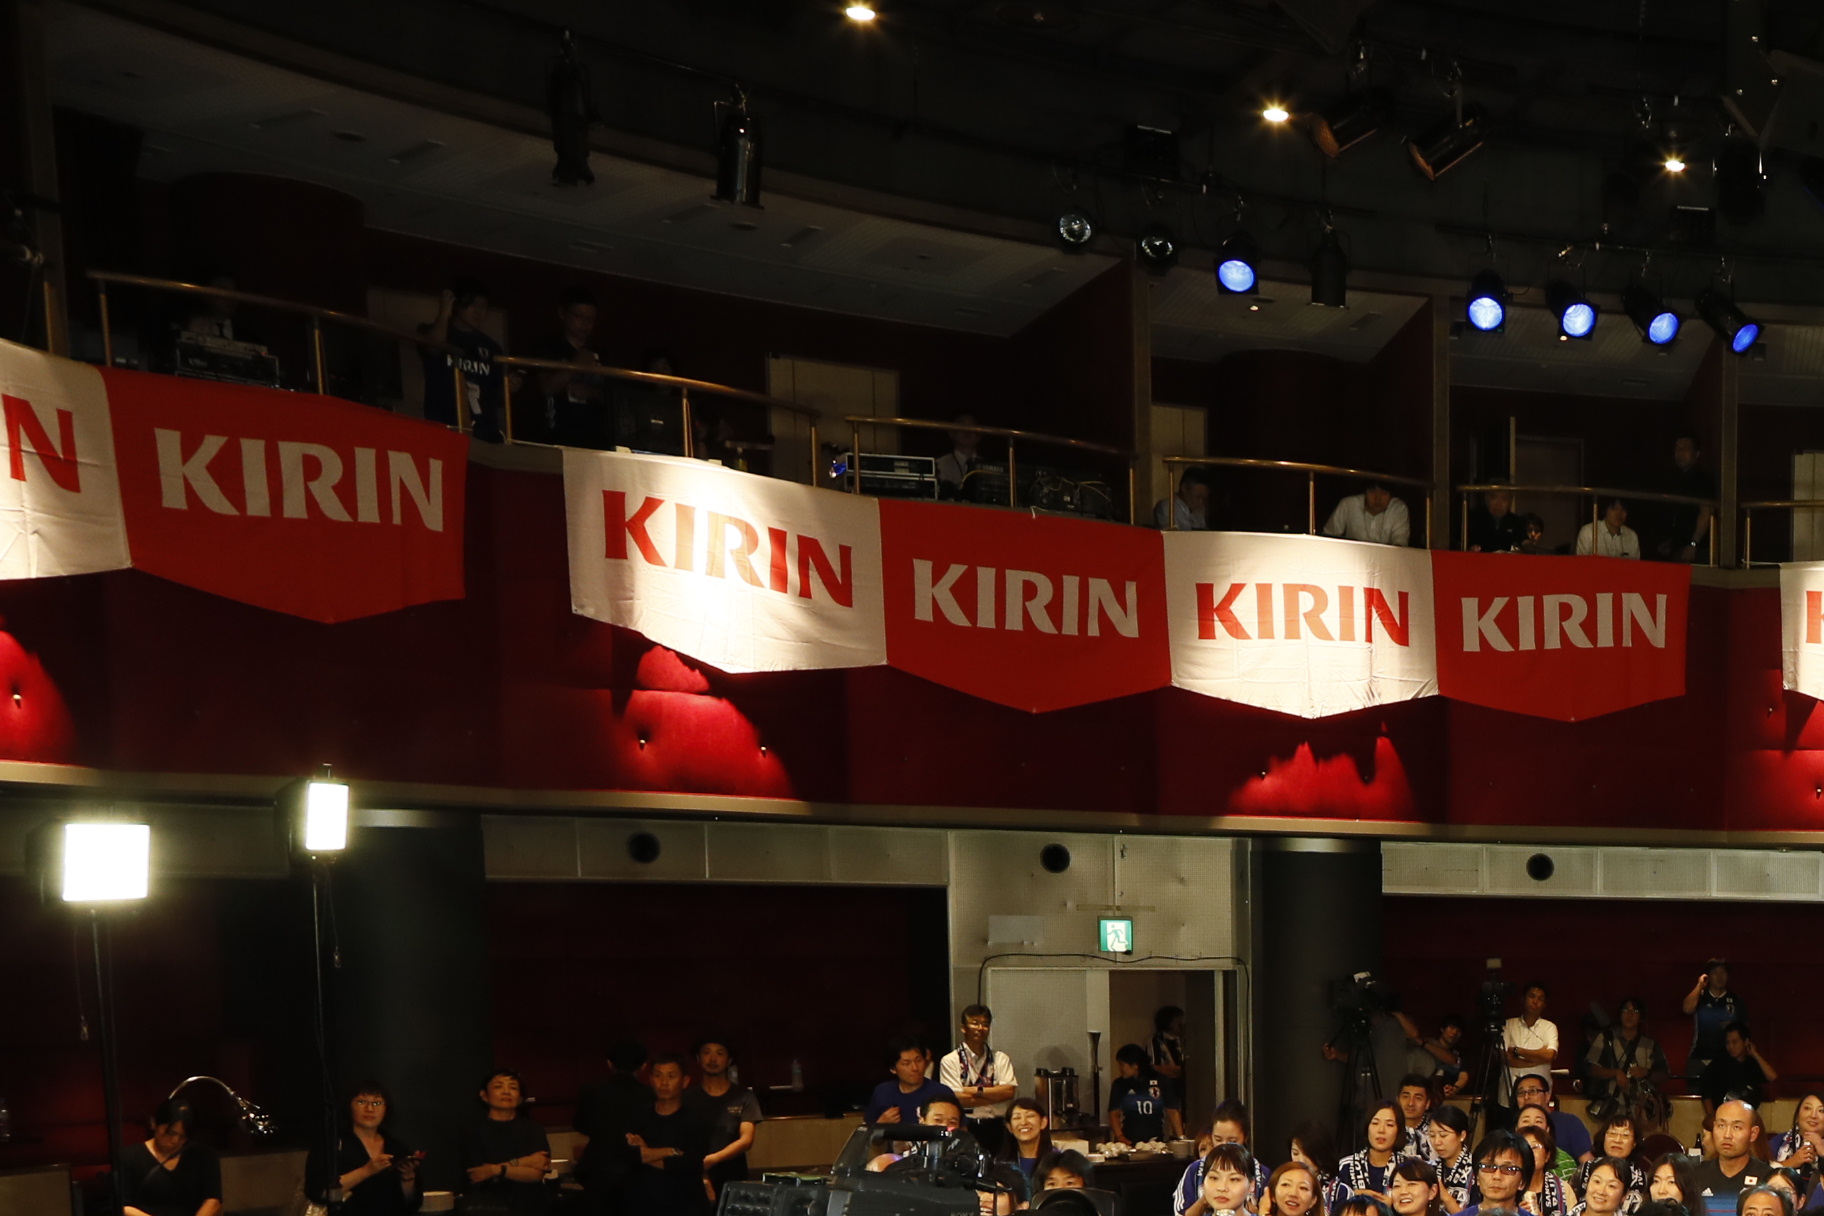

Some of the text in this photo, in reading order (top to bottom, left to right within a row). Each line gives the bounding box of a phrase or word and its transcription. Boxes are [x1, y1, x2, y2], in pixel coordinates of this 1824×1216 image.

[154, 427, 444, 532] KIRIN
[603, 489, 853, 608] KIRIN
[913, 558, 1140, 639] KIRIN
[1195, 582, 1411, 647] KIRIN
[1461, 592, 1668, 653] KIRIN
[1136, 1100, 1153, 1115] 10
